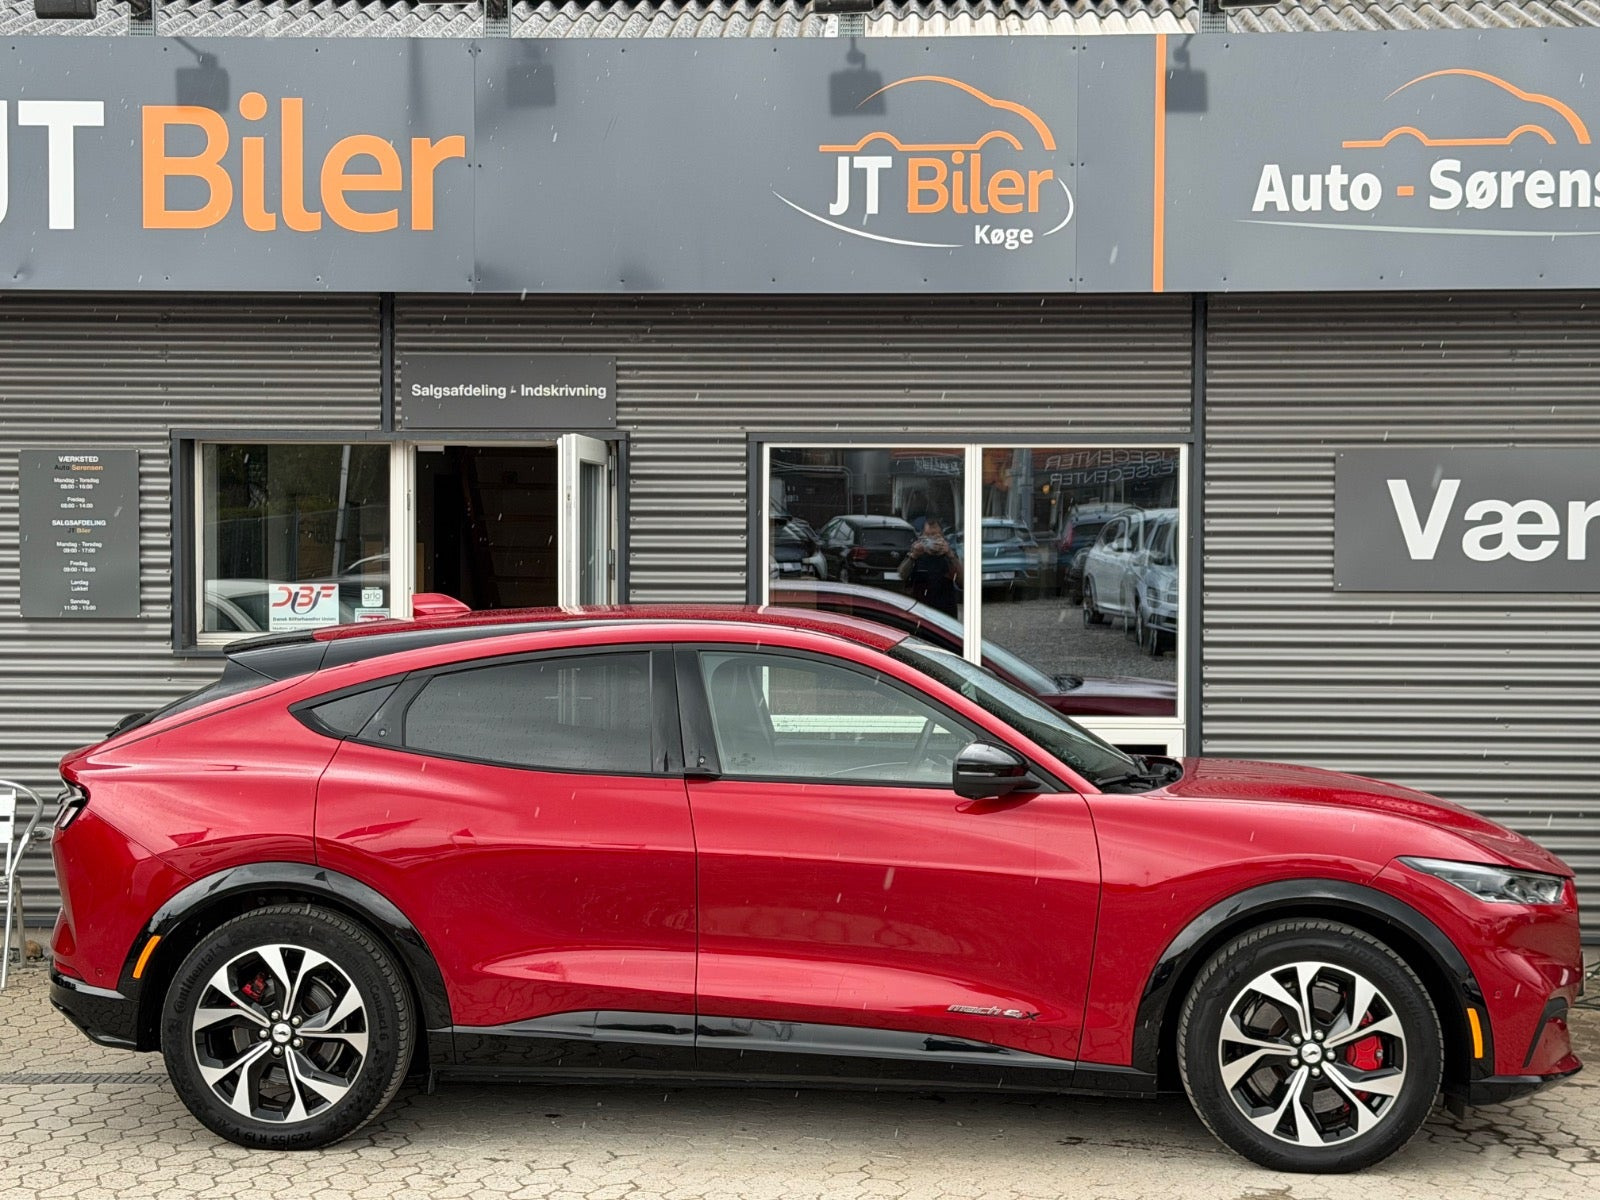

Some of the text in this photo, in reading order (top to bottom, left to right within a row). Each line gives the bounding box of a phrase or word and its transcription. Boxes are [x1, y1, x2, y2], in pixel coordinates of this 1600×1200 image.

[142, 92, 465, 232] Biler
[829, 151, 1053, 215] JT Biler
[1252, 164, 1382, 212] Auto
[1428, 158, 1600, 210] Søren
[973, 224, 1034, 250] Køge
[411, 384, 507, 399] Salgsafdeling
[521, 384, 607, 399] Indskrivning
[58, 455, 99, 463] VÆRKSTED
[1386, 479, 1600, 562] Vær
[363, 592, 381, 600] arlo
